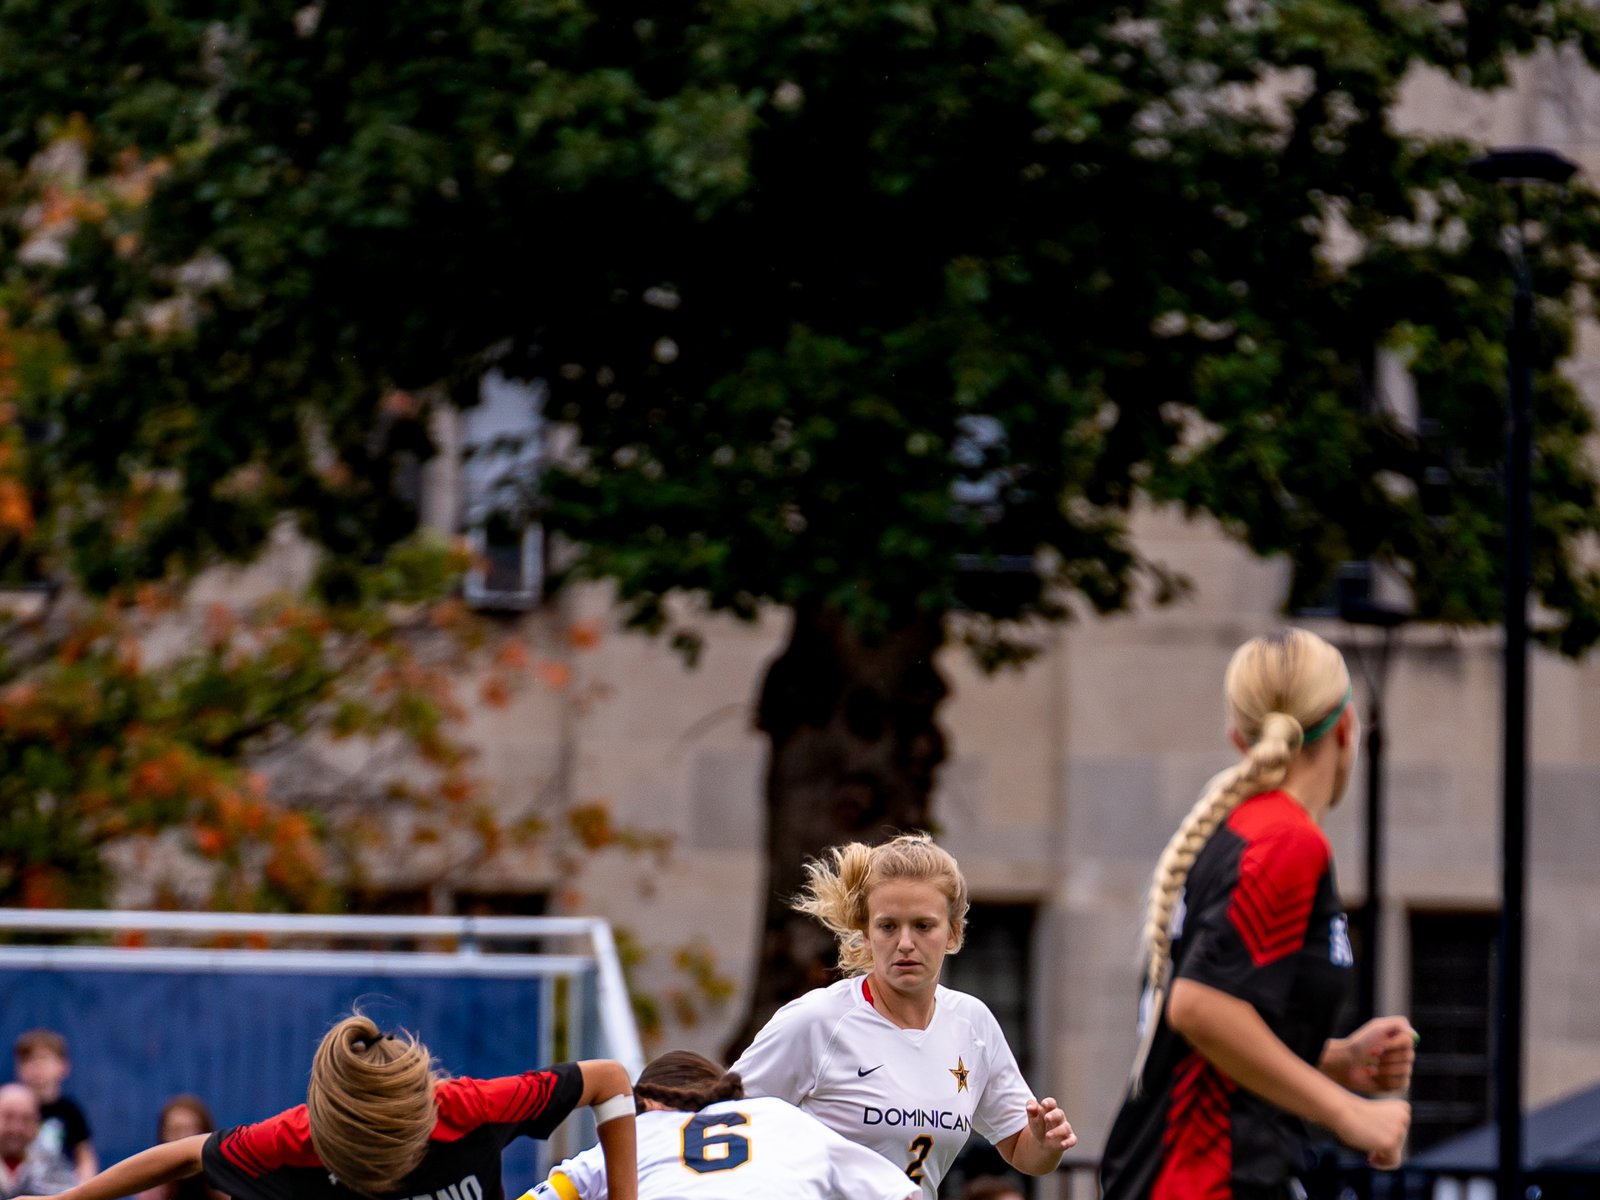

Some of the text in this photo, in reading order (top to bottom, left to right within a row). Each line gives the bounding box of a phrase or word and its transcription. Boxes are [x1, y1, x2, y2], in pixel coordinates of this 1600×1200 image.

[680, 1111, 752, 1175] 6
[863, 1106, 972, 1132] DOMINICAN
[905, 1134, 935, 1185] 2
